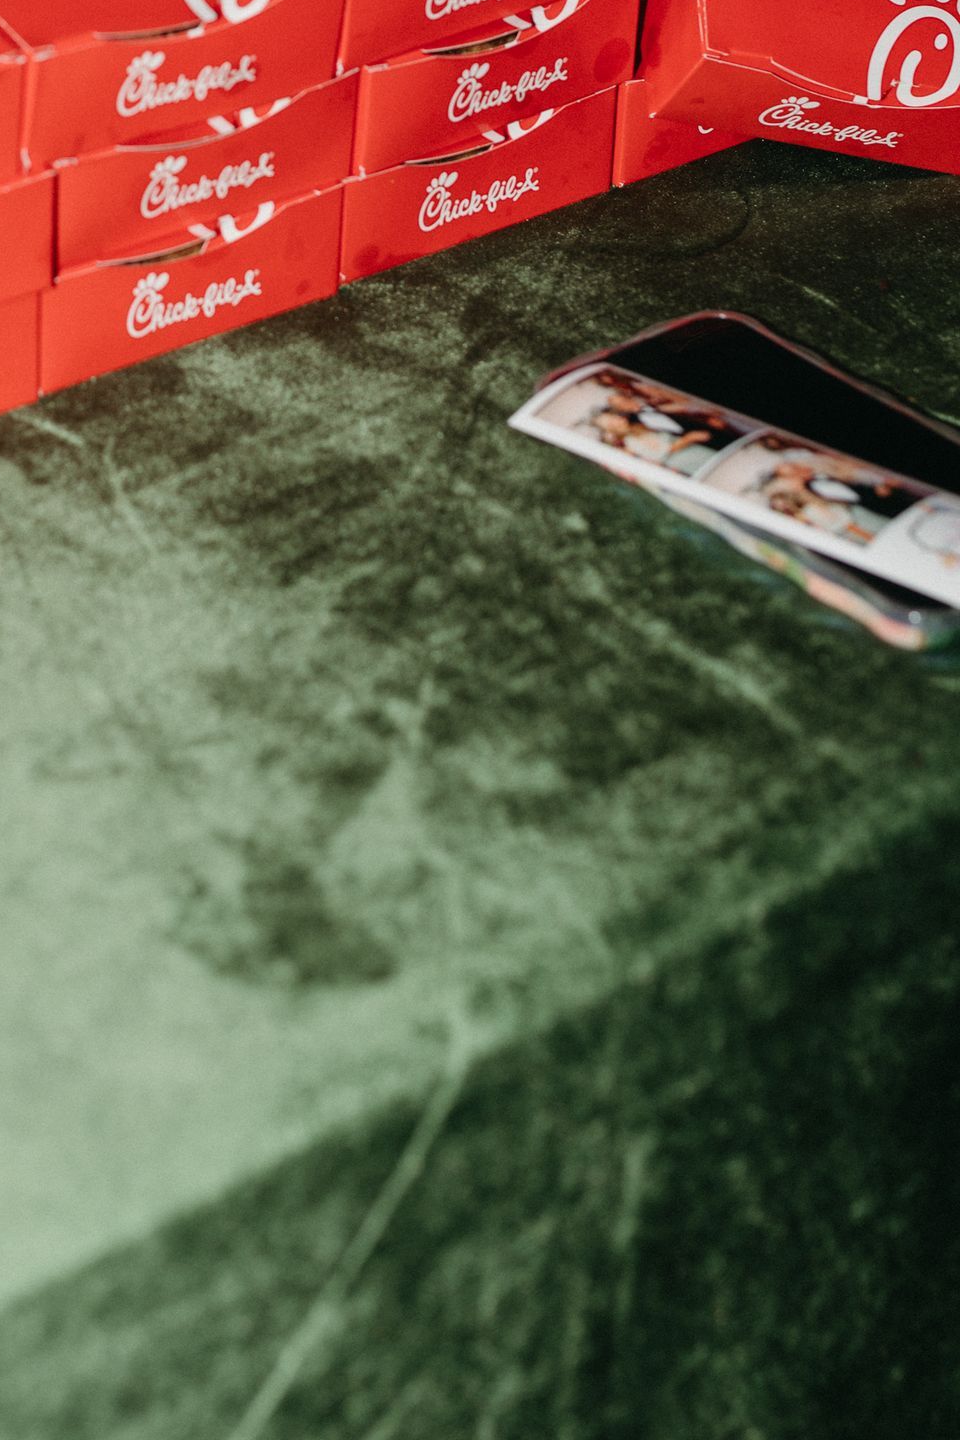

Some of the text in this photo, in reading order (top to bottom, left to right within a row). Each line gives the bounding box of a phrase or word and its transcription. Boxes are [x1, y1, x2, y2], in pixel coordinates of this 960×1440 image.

[116, 51, 257, 117] Chick-fil-A
[447, 58, 568, 124] Chick-fil-A
[758, 96, 900, 148] Chick-fil-A
[141, 152, 276, 219] Chick-fil-A
[418, 167, 540, 232] Chick-fil-A
[126, 269, 262, 338] Chick-fil-A
